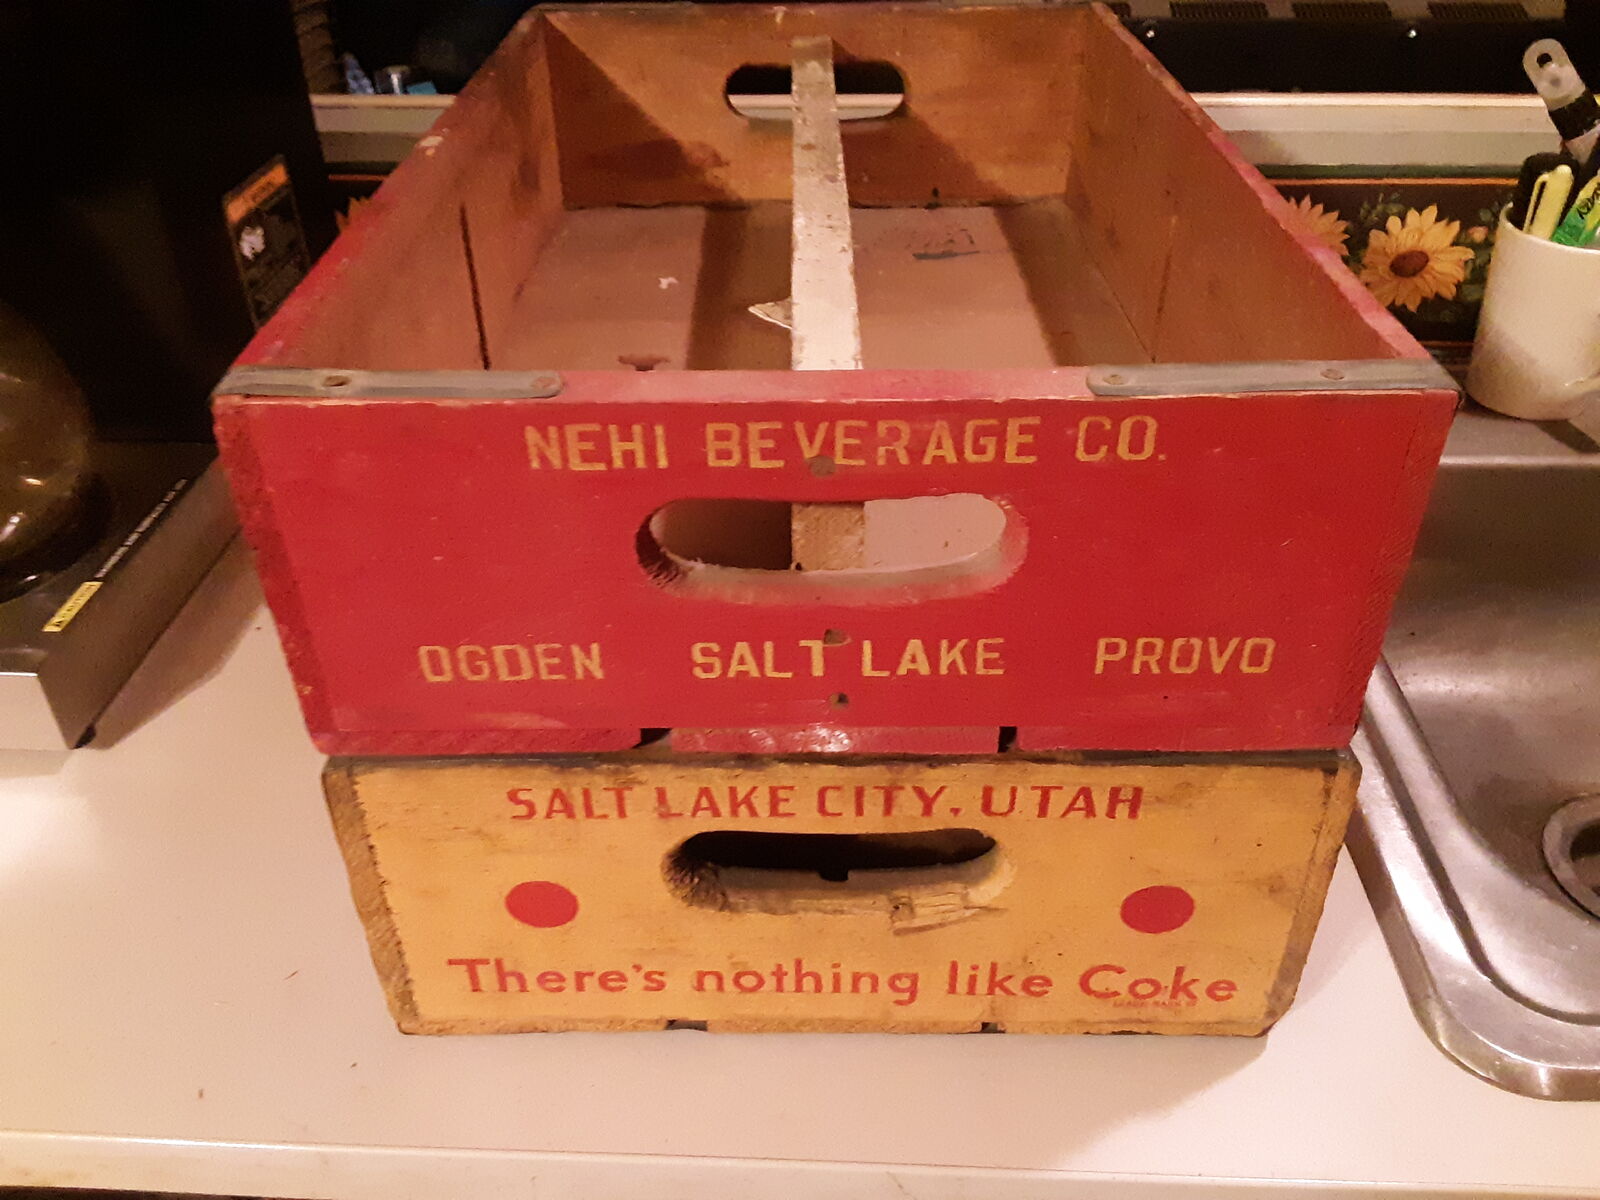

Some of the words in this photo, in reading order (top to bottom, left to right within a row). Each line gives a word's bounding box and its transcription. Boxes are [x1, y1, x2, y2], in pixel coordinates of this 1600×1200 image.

[524, 423, 669, 471] NEHI
[705, 416, 1041, 469] BEVERAGE
[1075, 415, 1166, 463] CO.
[418, 642, 606, 684] OGDEN
[691, 638, 828, 680] SALT
[861, 637, 1005, 677] LAKE
[1094, 637, 1276, 675] PROVO
[508, 787, 636, 820] SALT
[656, 786, 795, 819] LAKE
[981, 785, 1142, 820] UTAH
[447, 957, 667, 993] There's
[694, 957, 920, 1007] nothing
[947, 959, 1054, 998] like
[1078, 963, 1238, 1005] Coke
